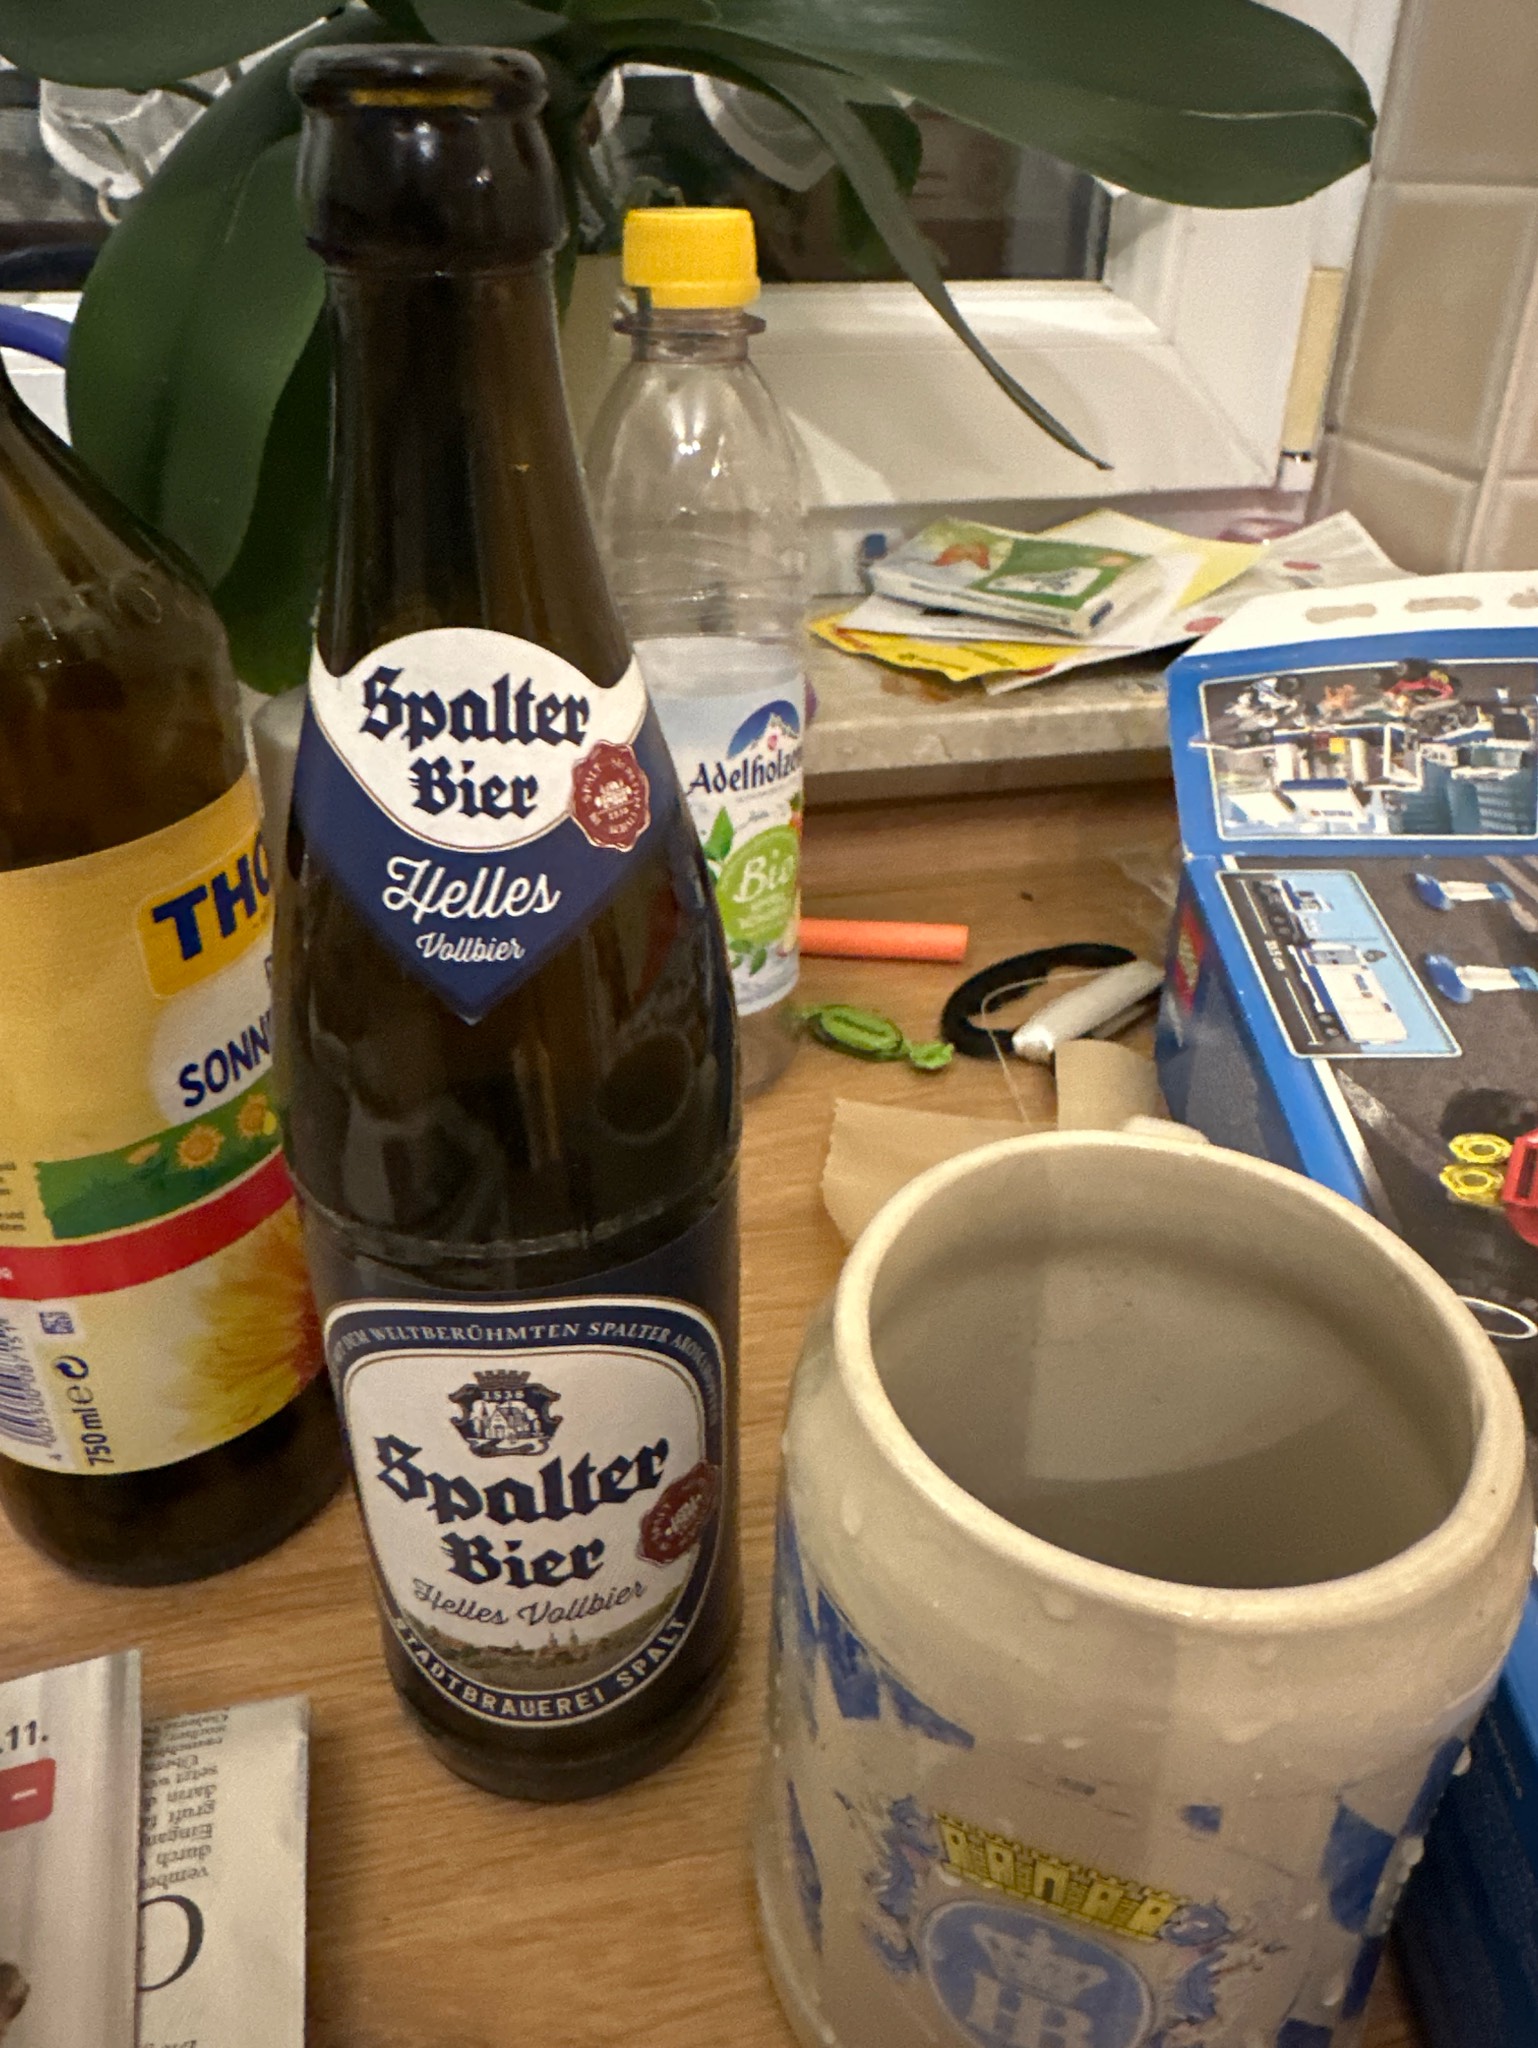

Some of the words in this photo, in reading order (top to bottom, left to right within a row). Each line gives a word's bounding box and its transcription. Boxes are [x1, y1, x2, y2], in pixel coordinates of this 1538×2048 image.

[360, 665, 590, 750] Spalter
[409, 756, 538, 819] Bier
[382, 855, 562, 924] Helles
[732, 849, 794, 904] Bio
[415, 932, 526, 963] Vollbier
[179, 1009, 271, 1107] SONN
[368, 1322, 581, 1342] WELTBERÜHMTEN
[587, 1321, 672, 1344] SPALTER
[72, 1407, 103, 1430] ml
[81, 1432, 115, 1467] 750
[373, 1434, 669, 1525] Spalter
[441, 1531, 606, 1589] Bier
[412, 1577, 509, 1625] Helles
[516, 1580, 648, 1627] Vollbier
[616, 1618, 686, 1688] SPALT
[142, 1823, 213, 1848] Eingan
[156, 1844, 212, 1868] durch
[145, 1866, 209, 1890] vembe
